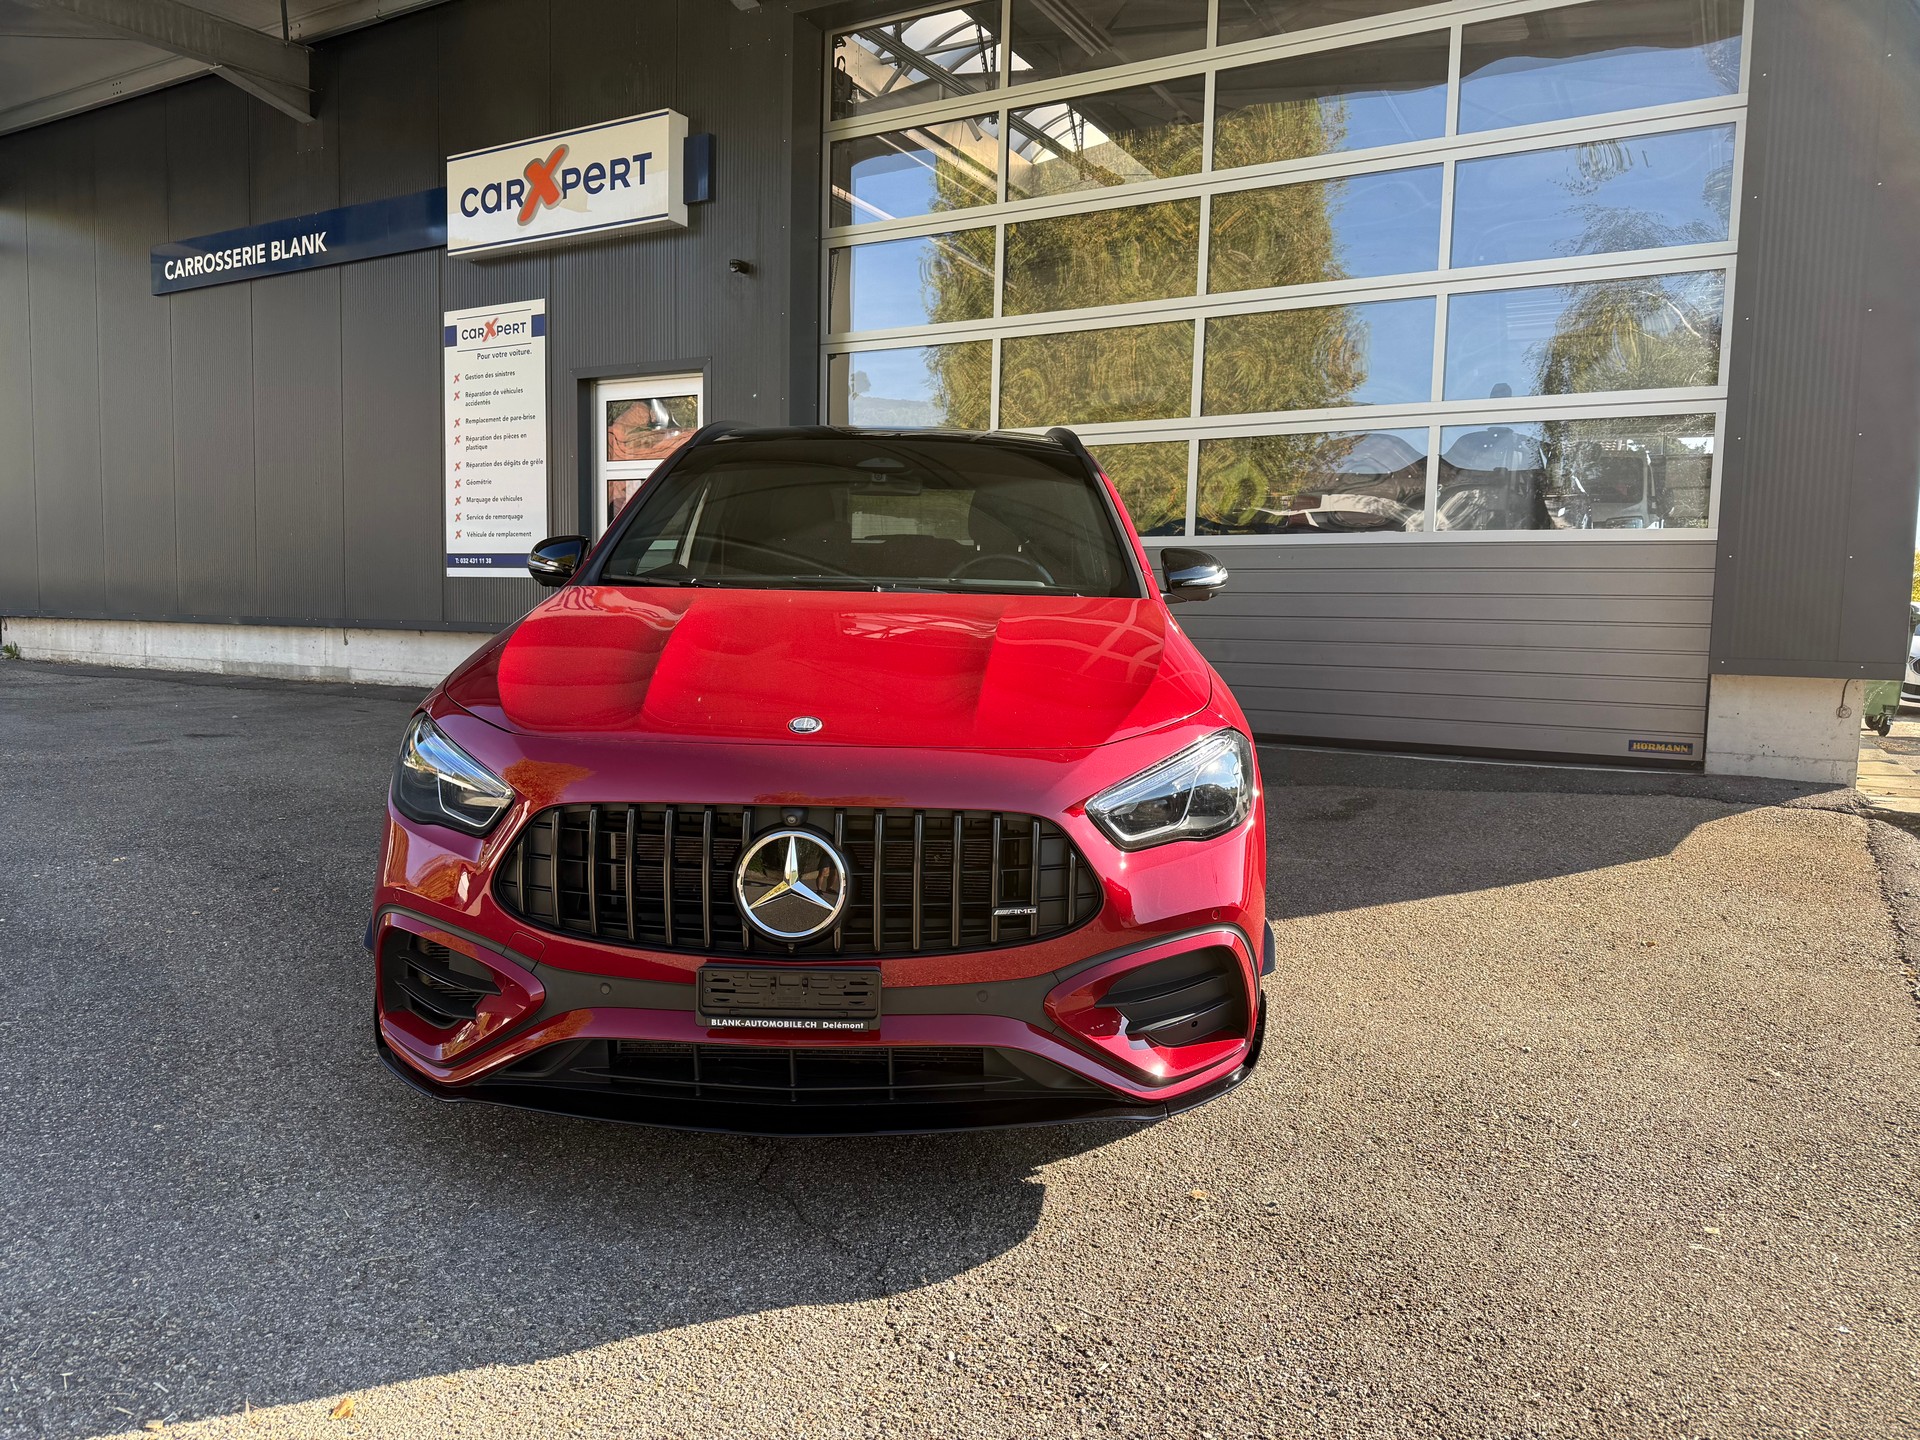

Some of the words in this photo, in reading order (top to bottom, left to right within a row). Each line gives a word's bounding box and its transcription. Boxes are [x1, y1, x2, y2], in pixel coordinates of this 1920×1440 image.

[164, 244, 266, 281] CARROSSERIE
[272, 232, 327, 261] BLANK
[465, 390, 491, 398] Réparation
[465, 416, 501, 425] Remplacement
[466, 435, 492, 443] Réparation
[504, 433, 520, 441] pièces
[466, 444, 488, 452] plastique
[711, 1019, 816, 1029] BLANK-AUTOMOBILE.CH
[823, 1021, 864, 1029] Delémont
